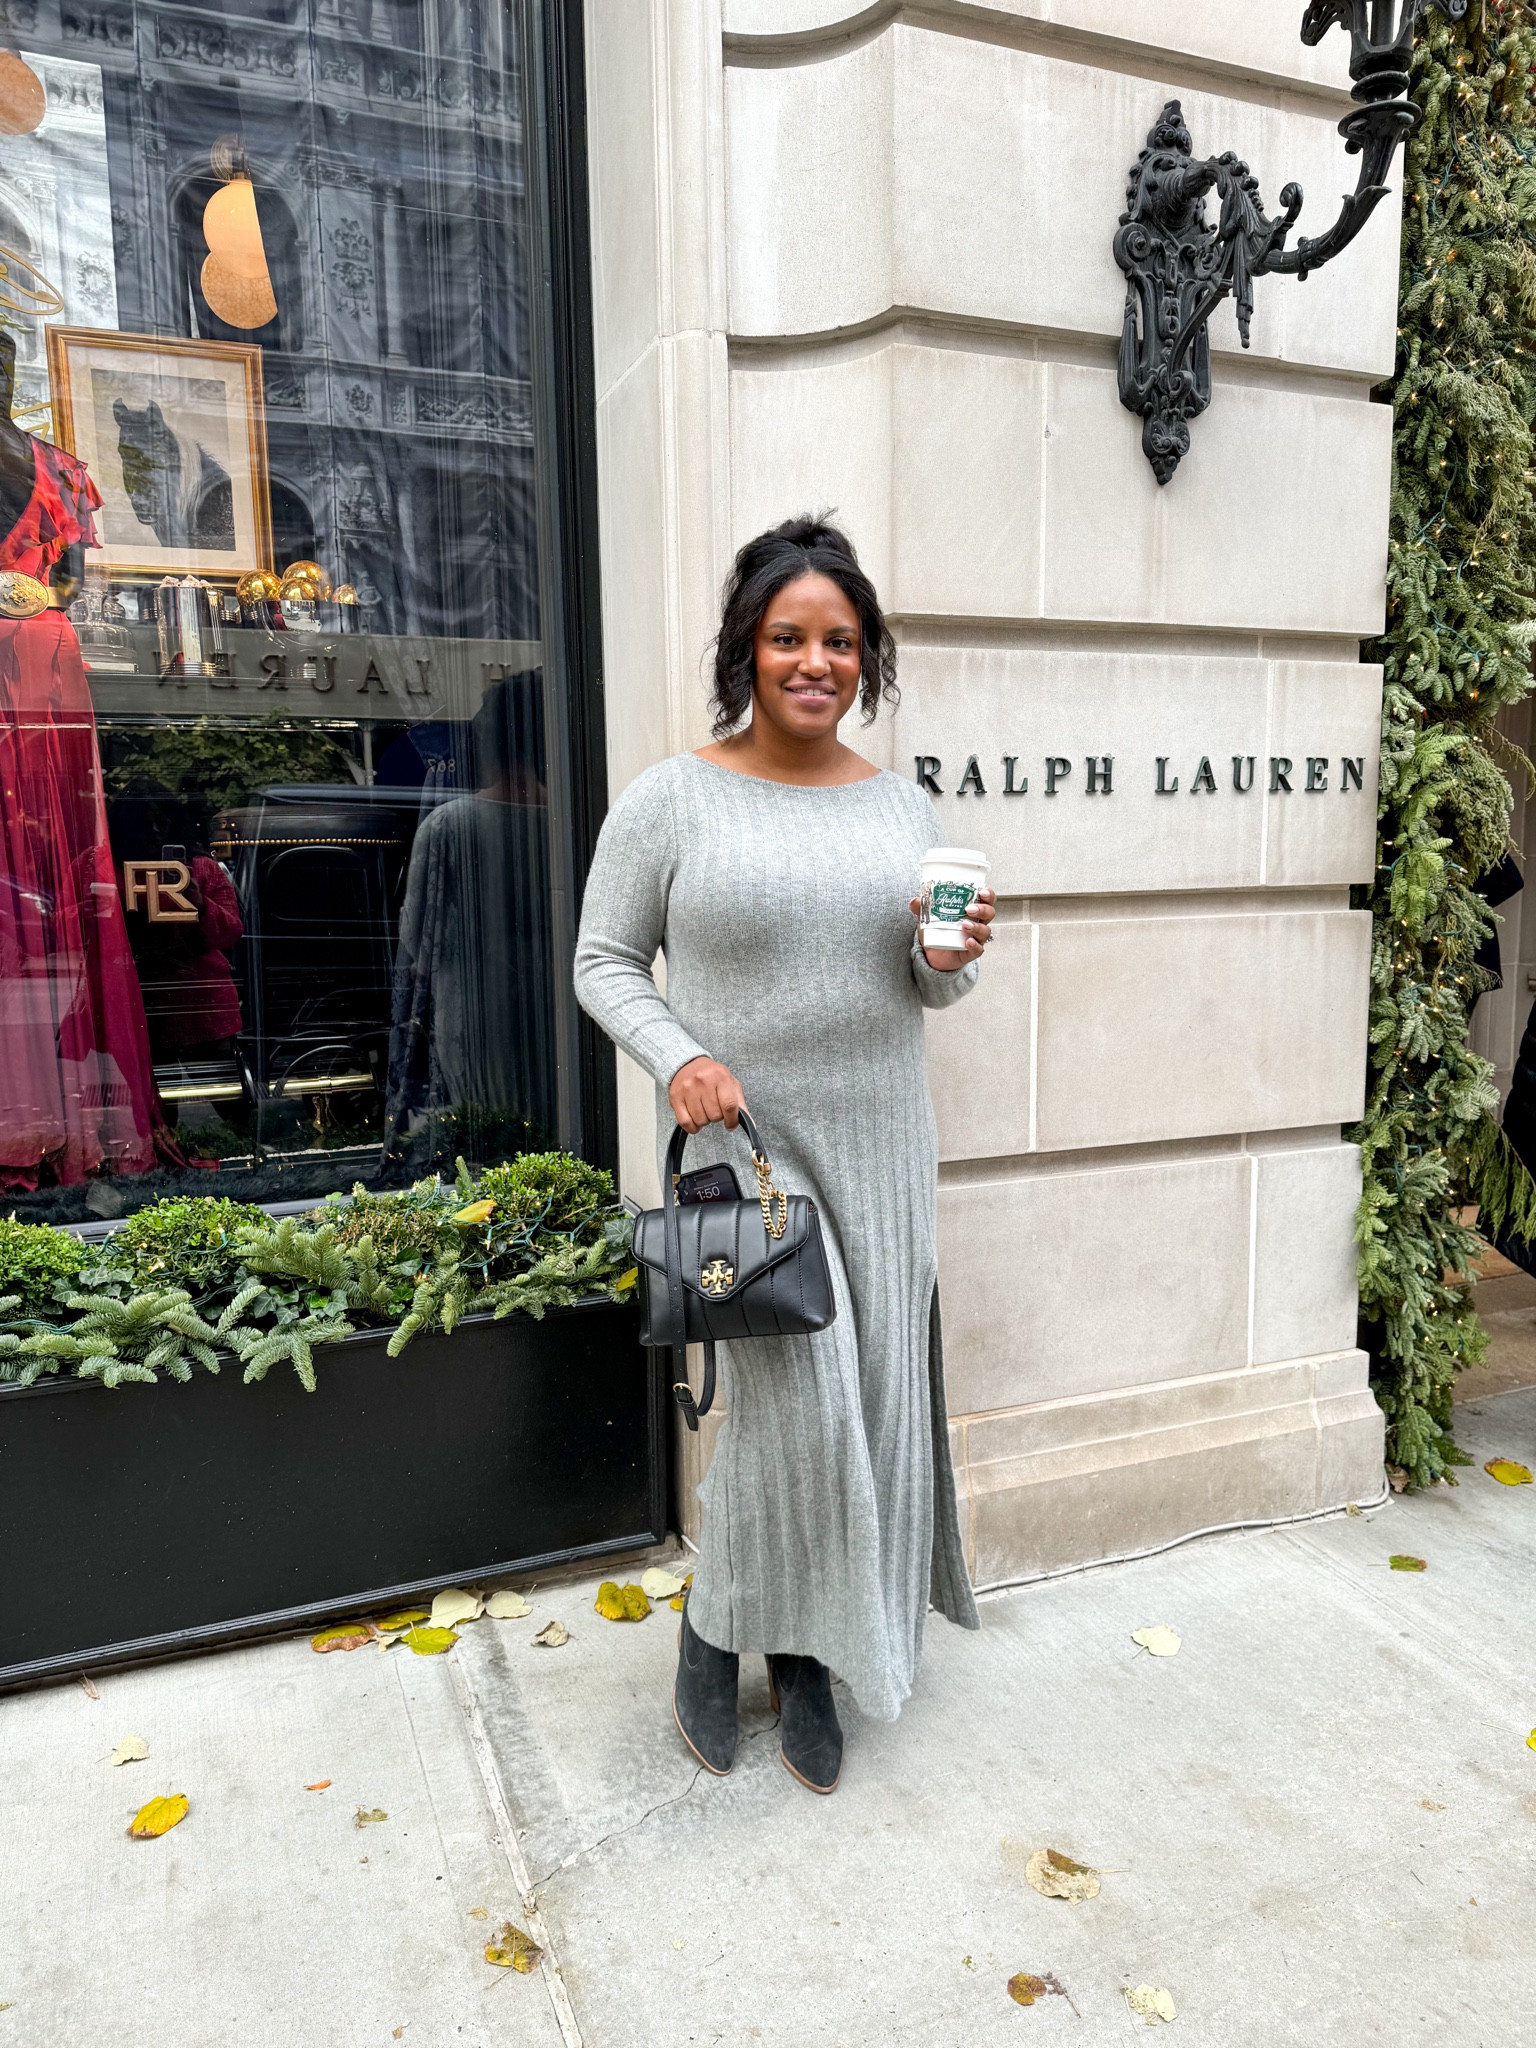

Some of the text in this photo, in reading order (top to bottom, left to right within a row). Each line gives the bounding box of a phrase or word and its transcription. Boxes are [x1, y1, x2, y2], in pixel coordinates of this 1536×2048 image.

[914, 754, 1366, 794] RALPH LAUREN
[696, 1185, 720, 1201] 1:50
